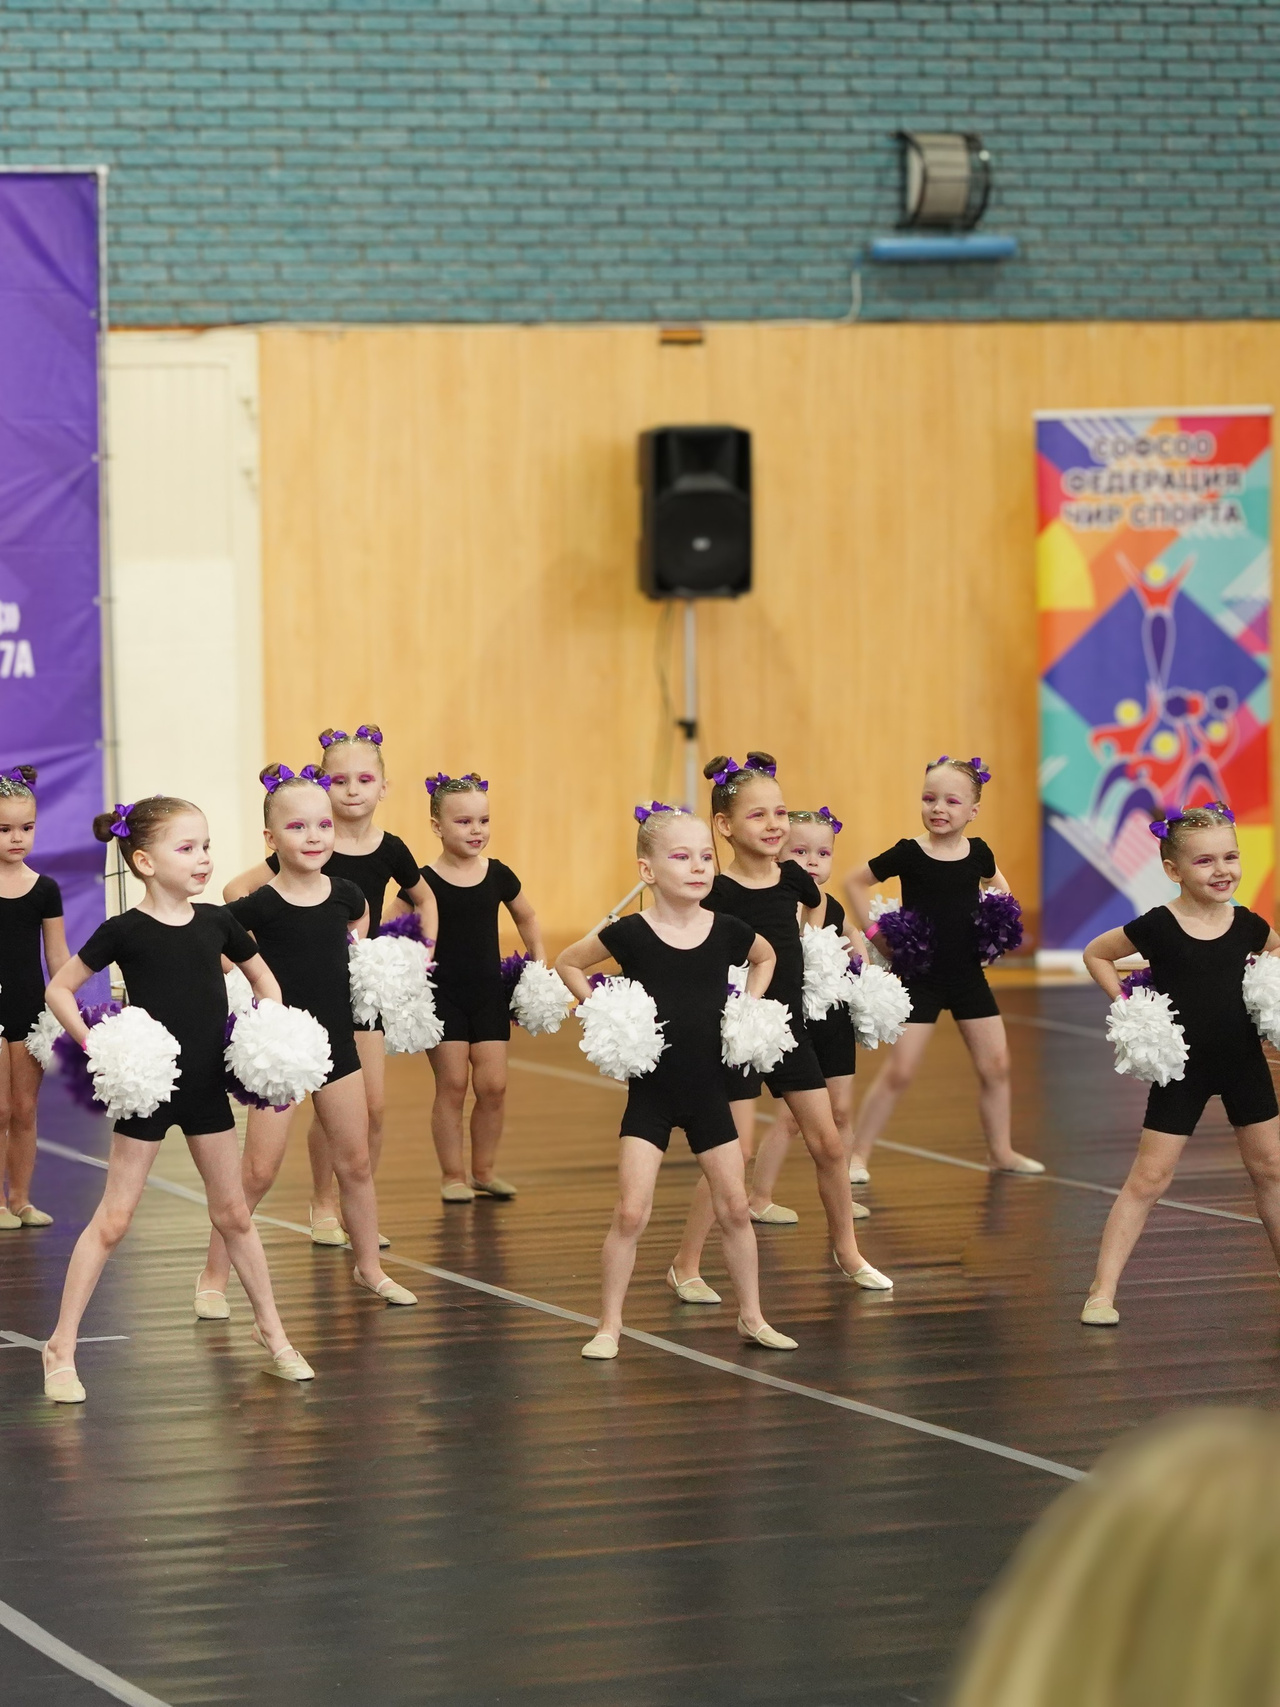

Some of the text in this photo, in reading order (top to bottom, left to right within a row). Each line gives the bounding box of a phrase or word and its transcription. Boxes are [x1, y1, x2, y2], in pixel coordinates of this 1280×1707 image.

[1091, 434, 1212, 460] СОФСОО
[1066, 469, 1243, 493] ФЕДЕРАЦИЯ
[1064, 500, 1243, 526] ЧИР СПОРТА
